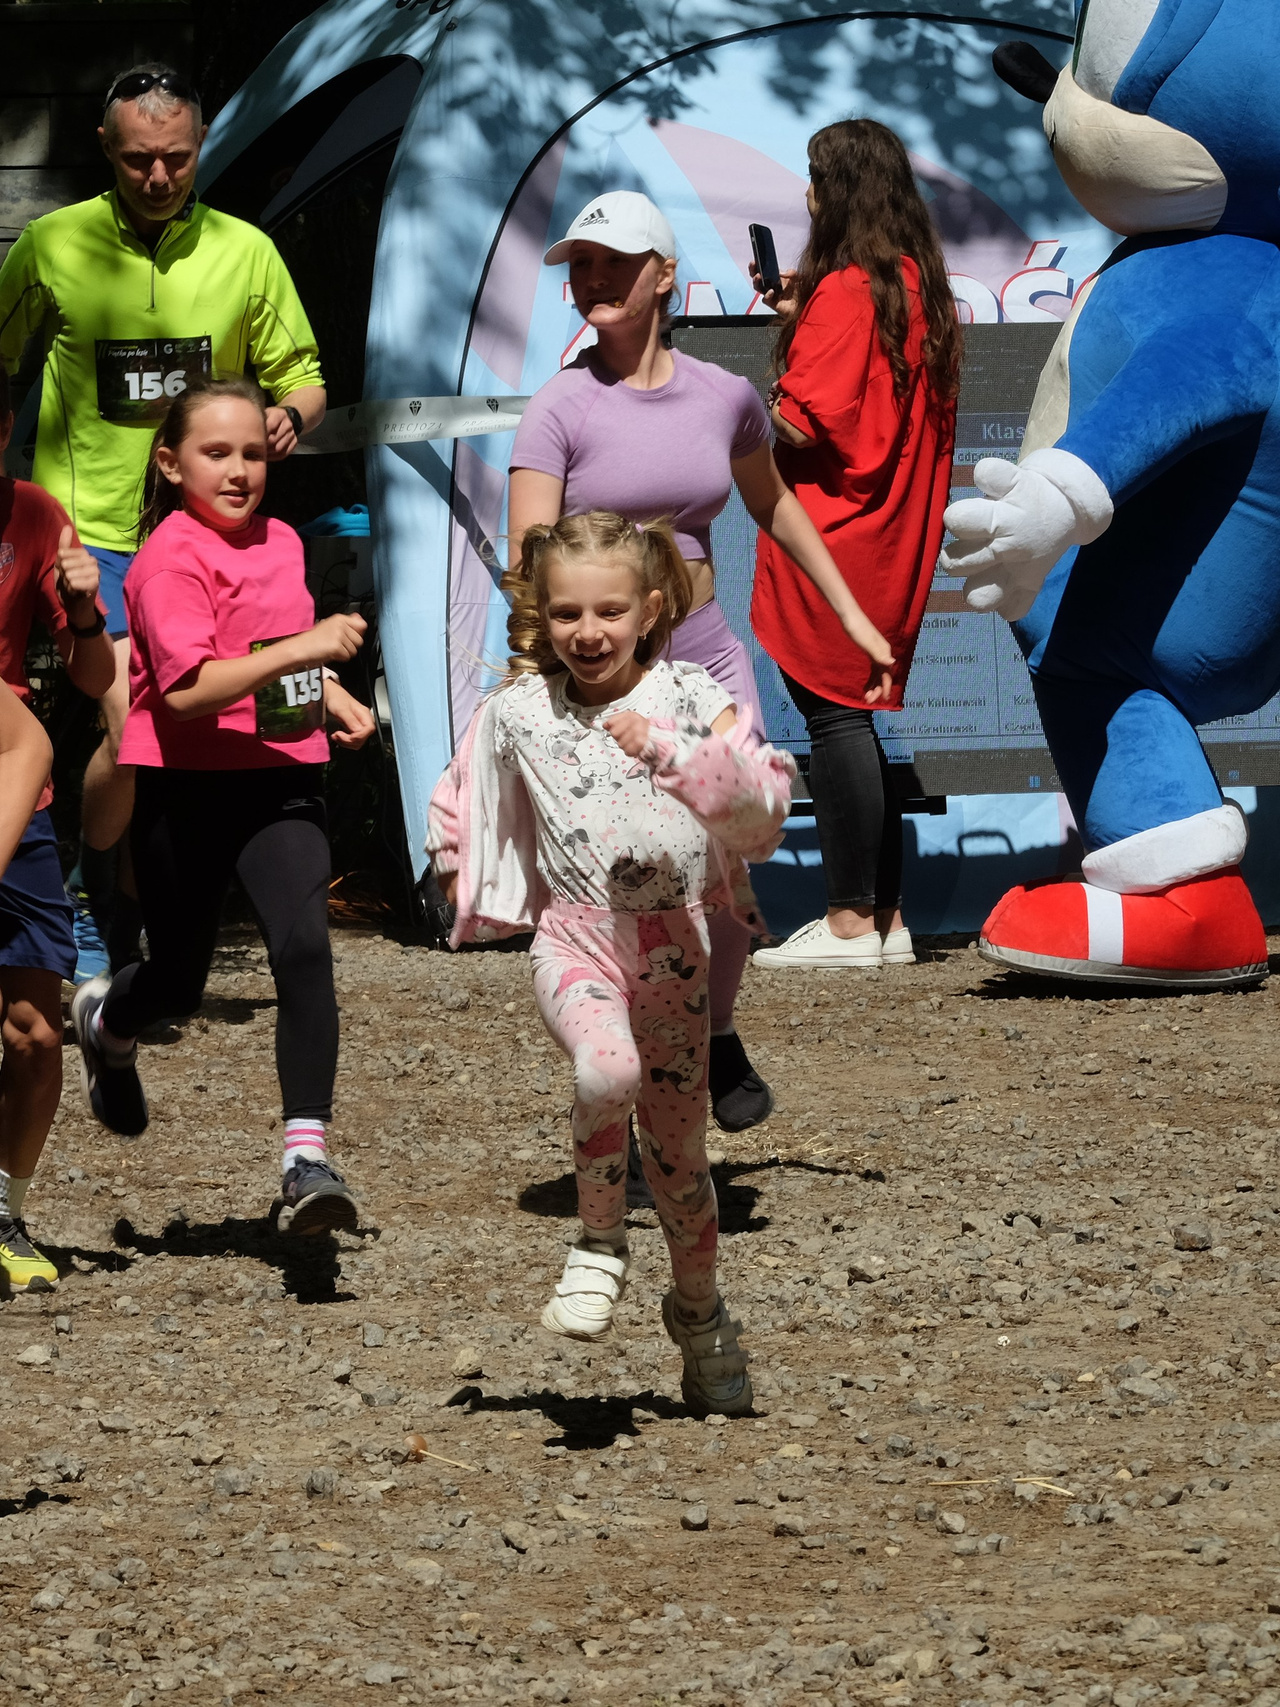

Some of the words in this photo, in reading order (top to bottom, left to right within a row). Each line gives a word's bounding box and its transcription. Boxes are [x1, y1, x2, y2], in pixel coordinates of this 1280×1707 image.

[579, 218, 610, 229] adidas
[124, 370, 187, 401] 156
[383, 422, 443, 433] PRECJOZA
[280, 667, 323, 708] 135
